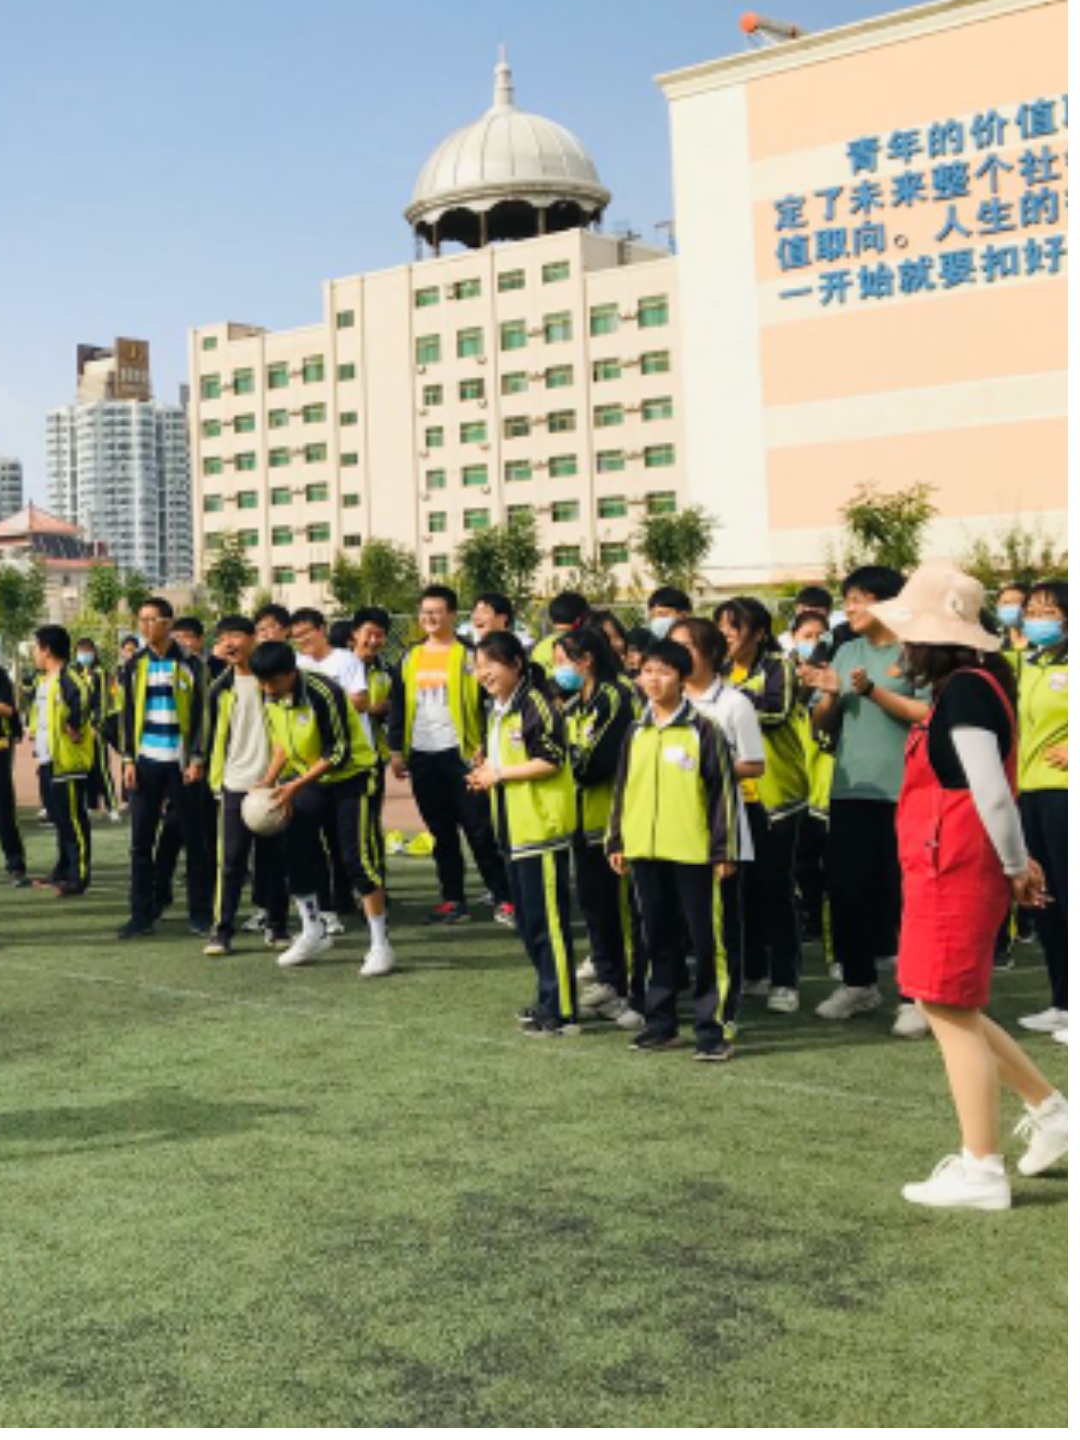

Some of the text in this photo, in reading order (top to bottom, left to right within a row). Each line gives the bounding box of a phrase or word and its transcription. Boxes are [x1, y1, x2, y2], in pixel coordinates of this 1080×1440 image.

[846, 94, 1068, 175] 青年的价值
[775, 145, 1068, 231] 定了未来整个社
[775, 186, 1068, 271] 值取向。人生的
[779, 234, 1067, 306] 一开始就要扣好
